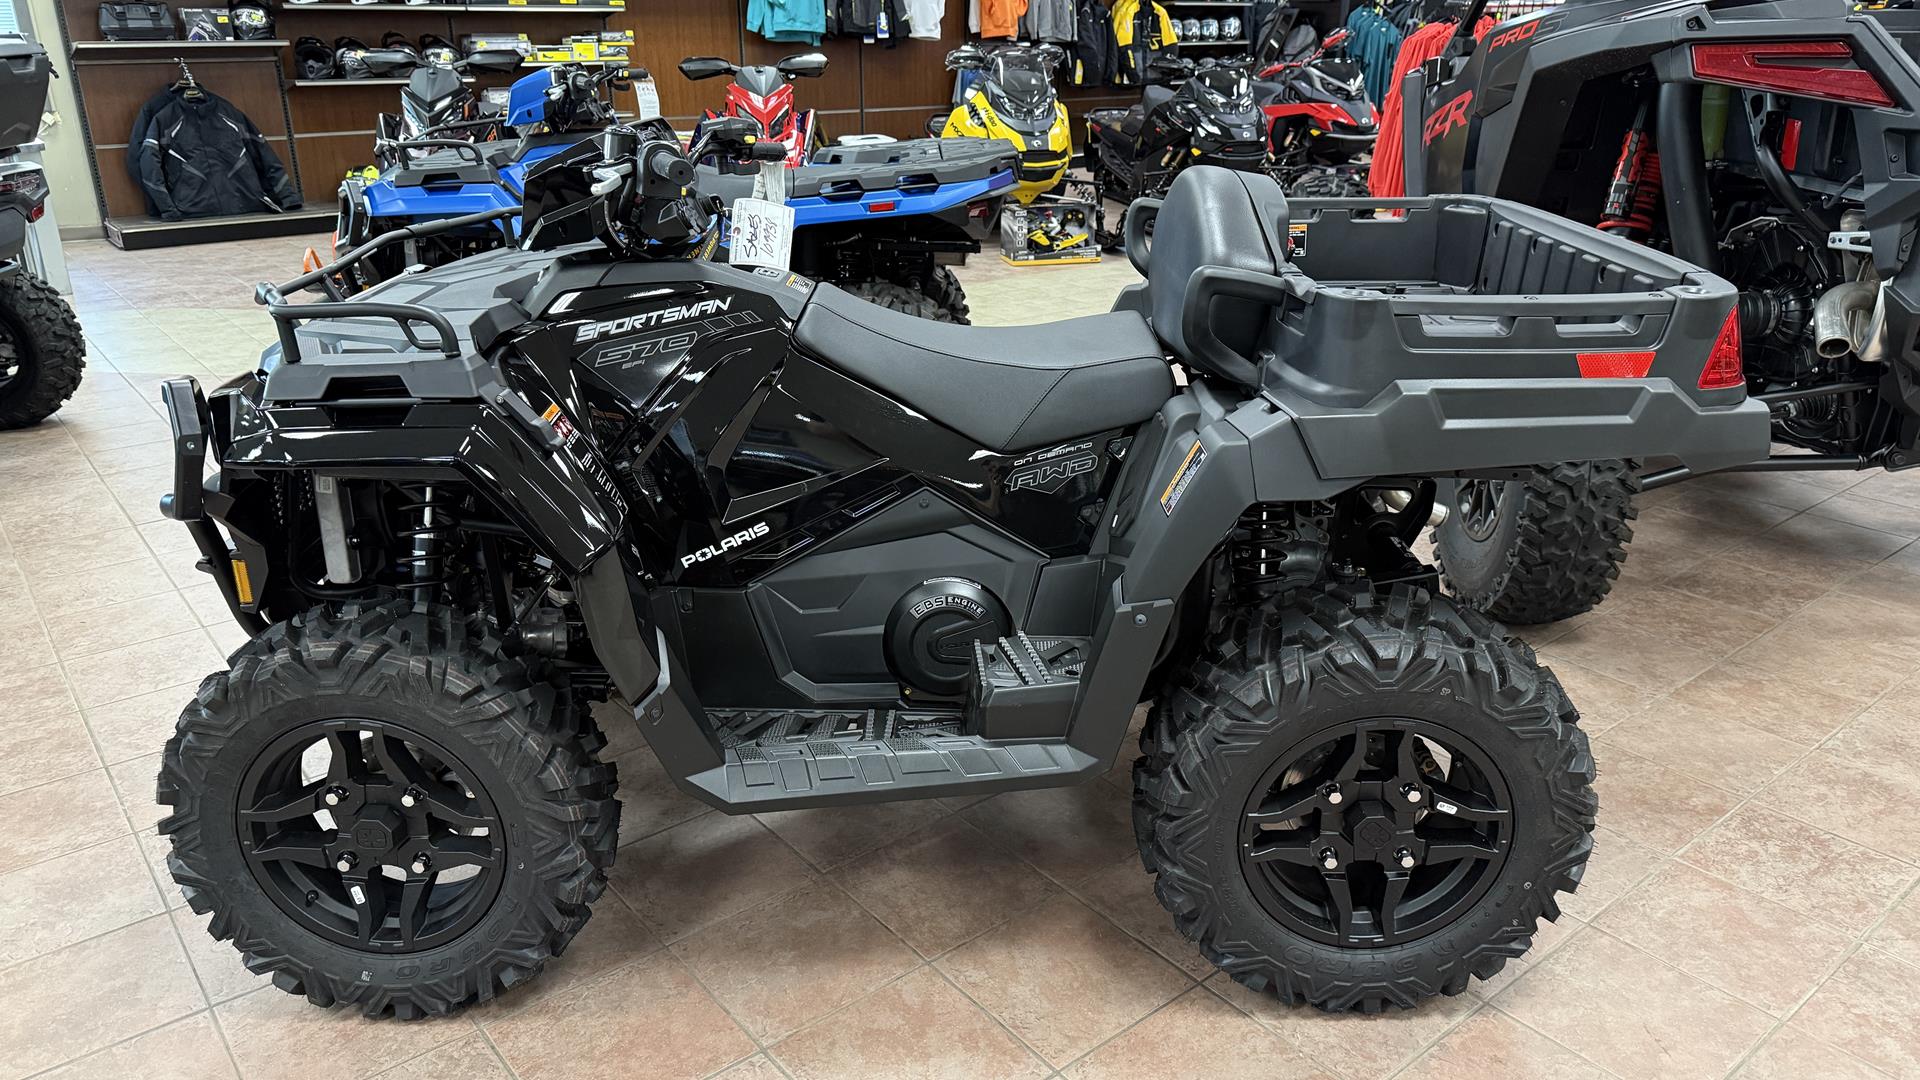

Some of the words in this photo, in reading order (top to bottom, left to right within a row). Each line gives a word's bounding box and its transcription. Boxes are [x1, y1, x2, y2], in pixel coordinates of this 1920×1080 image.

[1488, 19, 1541, 54] PRO
[1422, 89, 1474, 152] RZR
[575, 296, 733, 343] SPORTSMAN
[595, 331, 698, 368] 570
[1010, 455, 1099, 492] AWD
[680, 521, 770, 569] POLARIS
[913, 596, 945, 616] EBS
[946, 596, 984, 614] ENGINE
